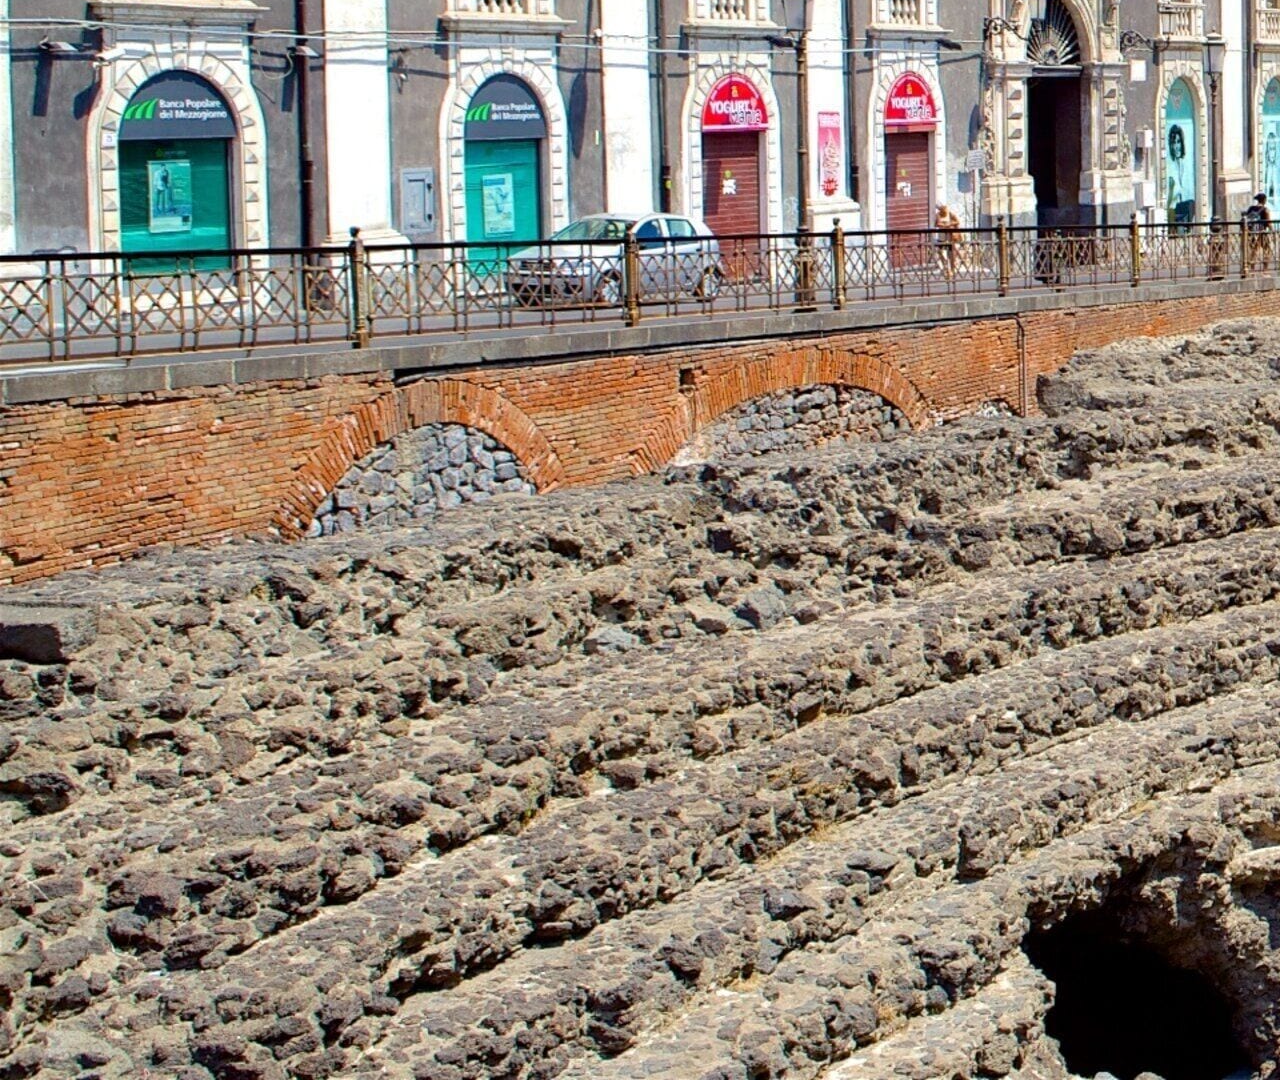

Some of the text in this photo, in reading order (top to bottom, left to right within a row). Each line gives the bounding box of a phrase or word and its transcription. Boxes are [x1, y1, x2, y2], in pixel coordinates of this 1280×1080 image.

[159, 98, 221, 110] Banca Popolare
[491, 102, 536, 112] Banca Popolare
[709, 100, 750, 115] YOGURT
[890, 96, 922, 110] YOGURT
[159, 109, 227, 121] del Mezzogiorno
[491, 111, 541, 122] del Mezzogiorno
